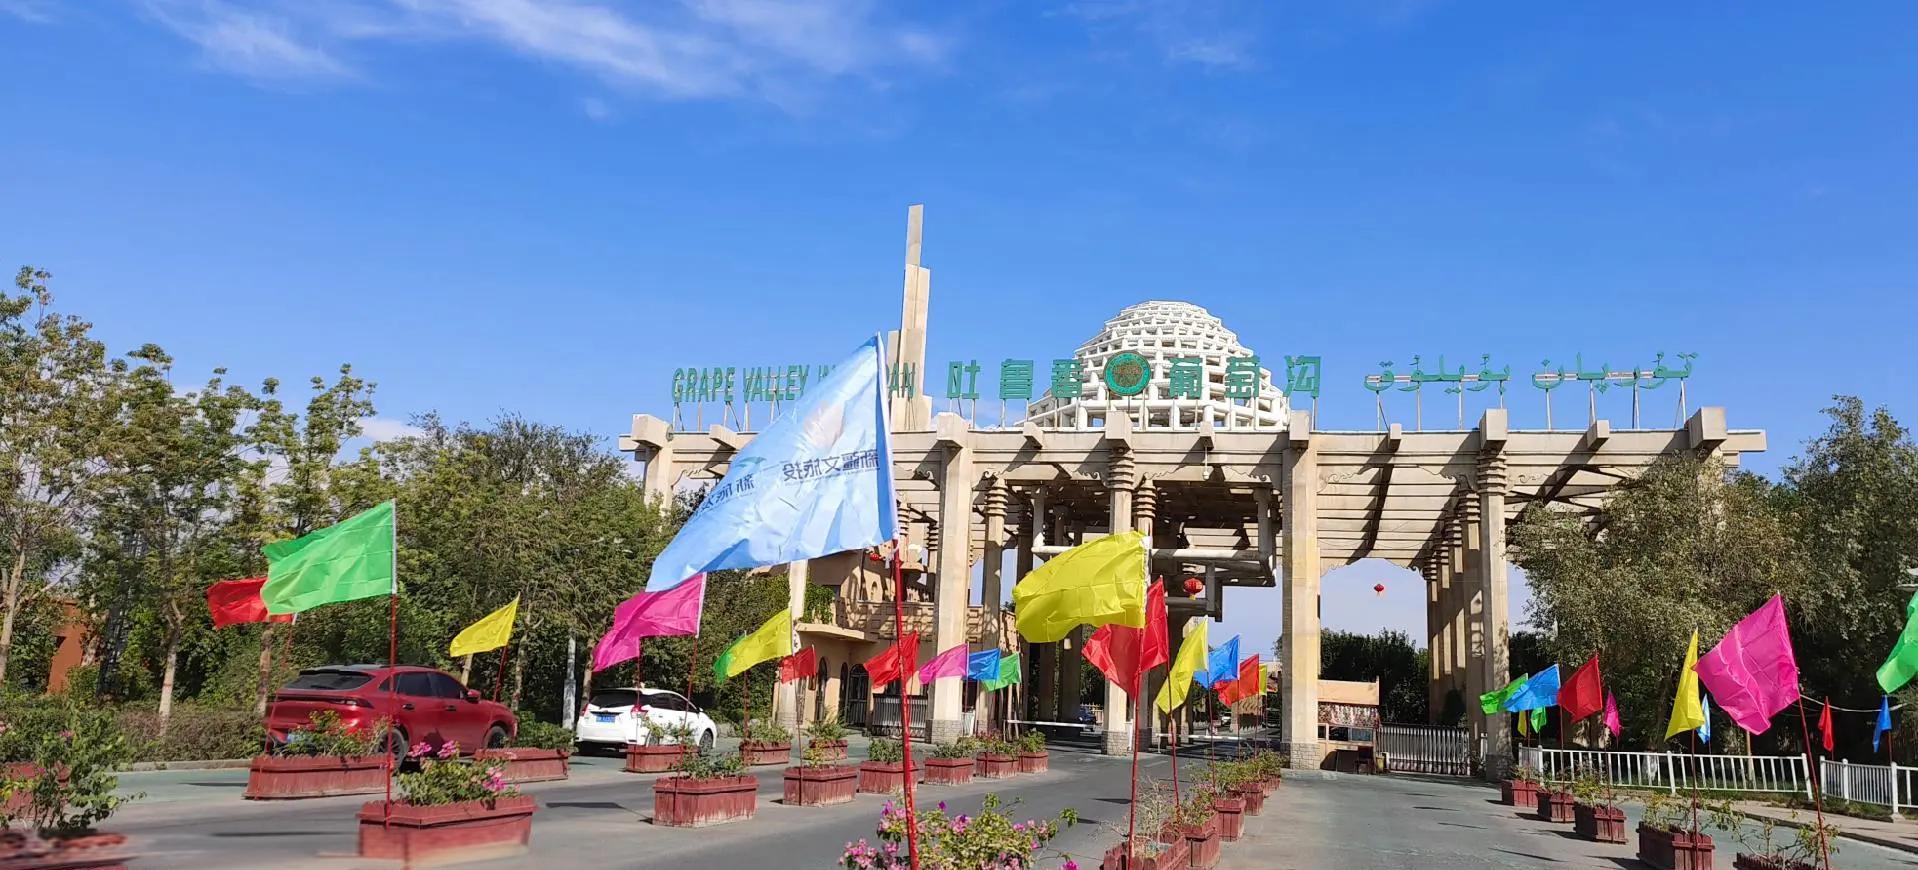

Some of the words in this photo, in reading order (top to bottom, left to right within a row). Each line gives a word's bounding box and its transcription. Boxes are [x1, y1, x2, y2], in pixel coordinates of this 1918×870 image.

[672, 366, 736, 402] GRAPE
[743, 364, 810, 401] VALLEY
[946, 358, 1083, 400] 吐鲁番
[1168, 355, 1323, 399] 葡萄沟
